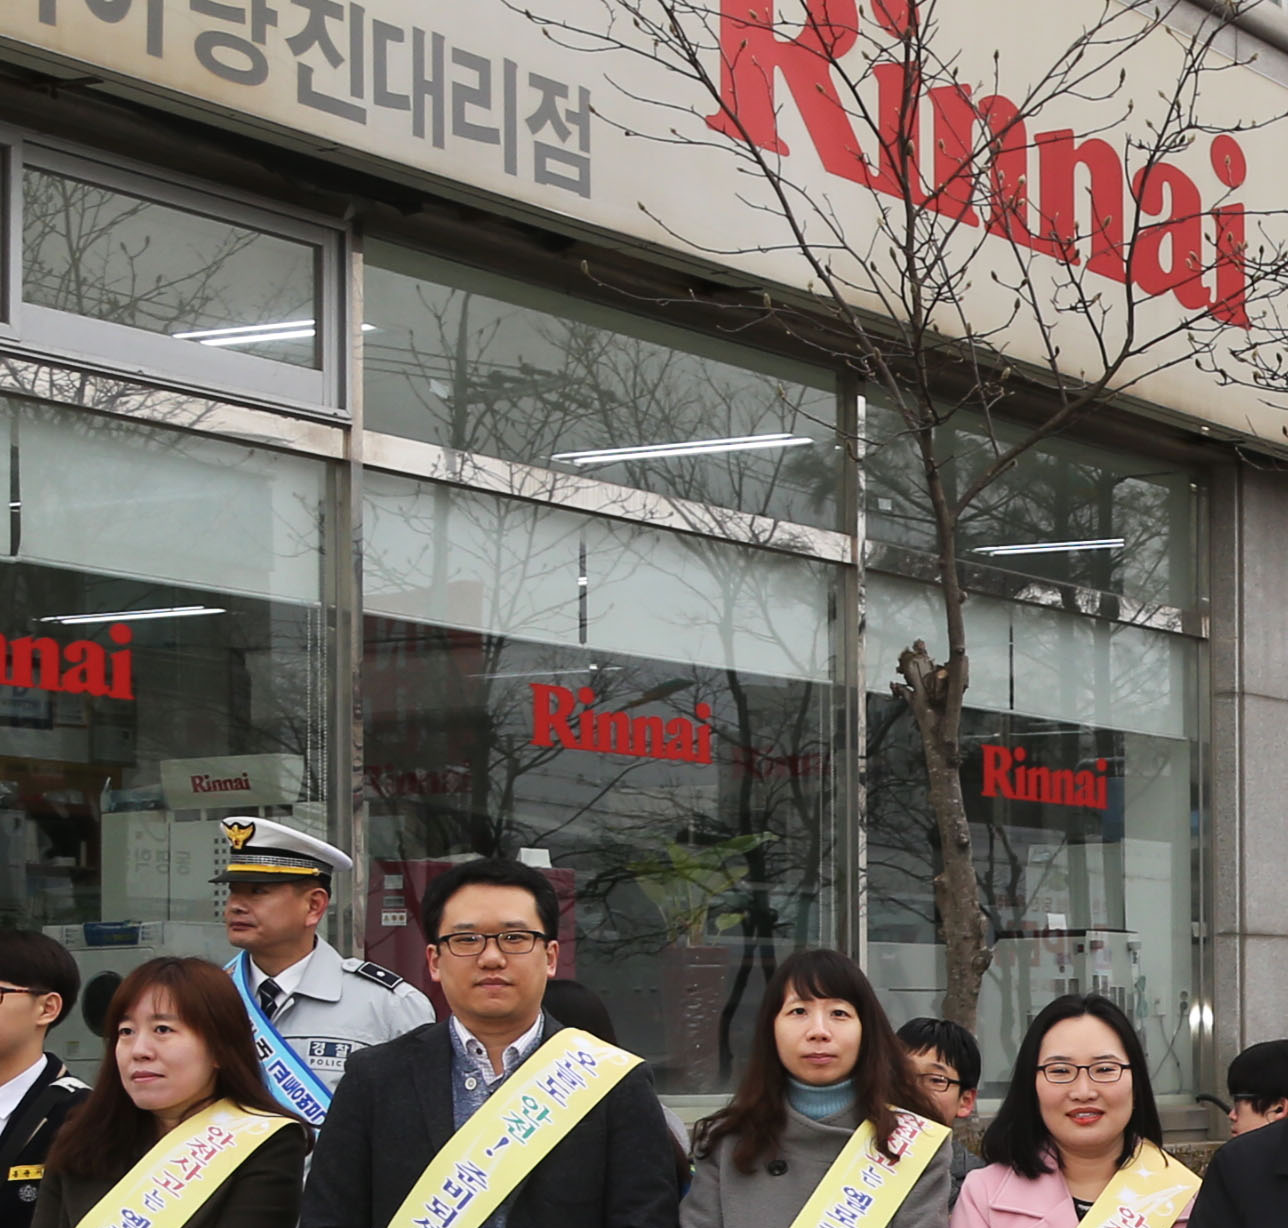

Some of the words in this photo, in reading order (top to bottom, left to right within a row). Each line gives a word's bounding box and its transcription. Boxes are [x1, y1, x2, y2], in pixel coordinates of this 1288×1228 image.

[704, 0, 1253, 331] Rinnai
[0, 622, 135, 700] nai
[528, 682, 712, 765] Rinnai
[190, 771, 251, 795] Rinnai
[980, 743, 1109, 810] Rinnai
[310, 1058, 343, 1067] POLIC
[537, 1049, 599, 1108] 오늘도
[143, 1124, 236, 1213] 안전사고는
